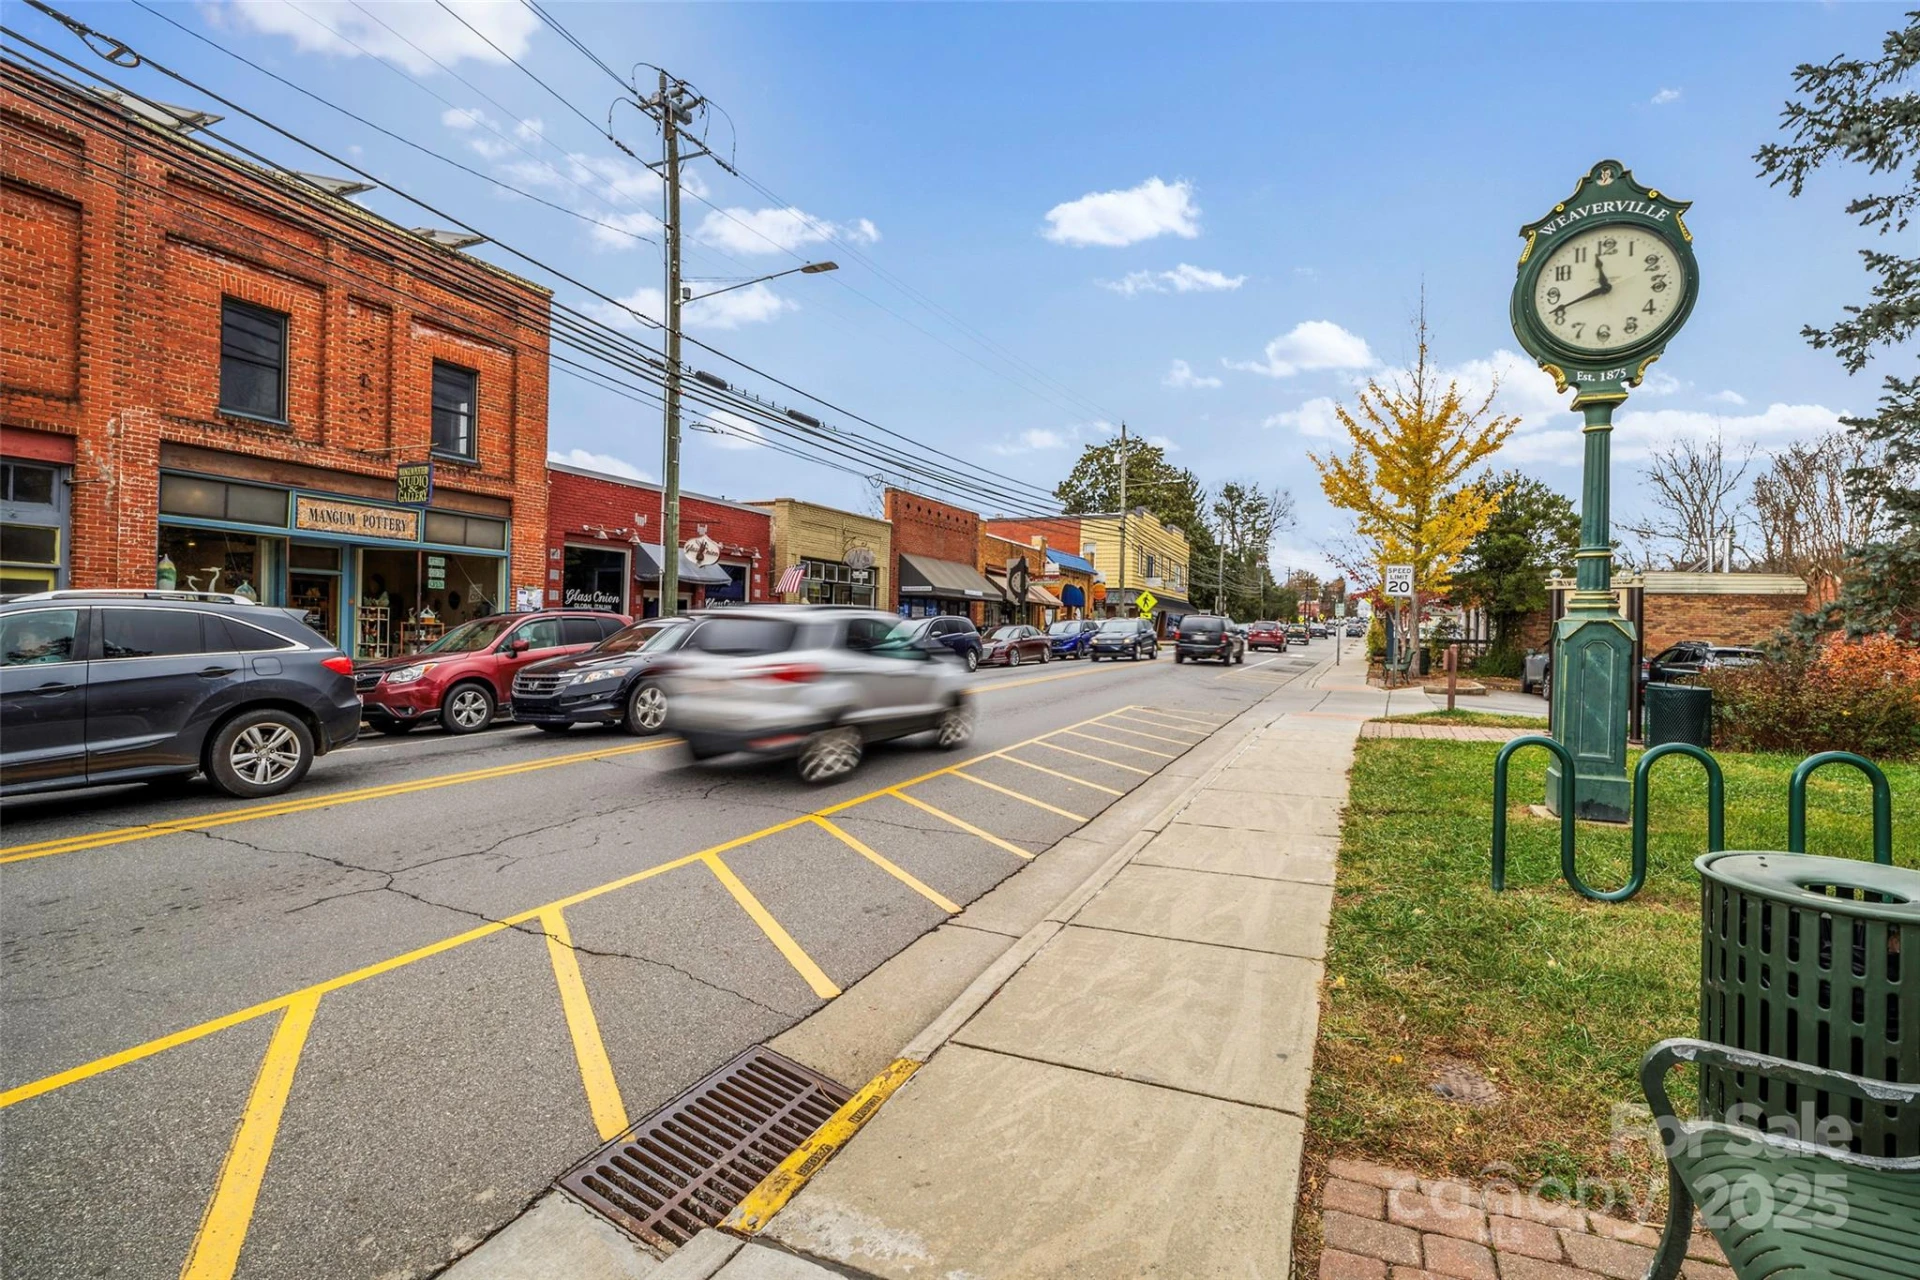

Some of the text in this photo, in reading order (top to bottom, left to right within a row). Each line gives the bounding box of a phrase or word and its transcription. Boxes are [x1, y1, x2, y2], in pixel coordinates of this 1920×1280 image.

[1539, 200, 1670, 235] WEAVERVILLE
[1575, 247, 1587, 264] 11
[1597, 239, 1618, 257] 12
[1628, 241, 1635, 257] 1
[1644, 254, 1660, 272] 2
[1555, 265, 1571, 282] 10
[1651, 274, 1667, 293] 3
[1547, 287, 1561, 305] 9
[1554, 306, 1566, 326] 8
[1642, 299, 1657, 316] 4
[1571, 322, 1586, 339] 7
[1596, 324, 1611, 342] 6
[1624, 316, 1638, 335] 5
[1576, 368, 1627, 381] Est. 1875
[398, 475, 429, 488] STUDIO
[398, 488, 429, 503] GALLERY
[308, 507, 407, 532] MANGUM POTTERY
[1388, 580, 1410, 593] 20
[564, 588, 620, 605] Glass Onion
